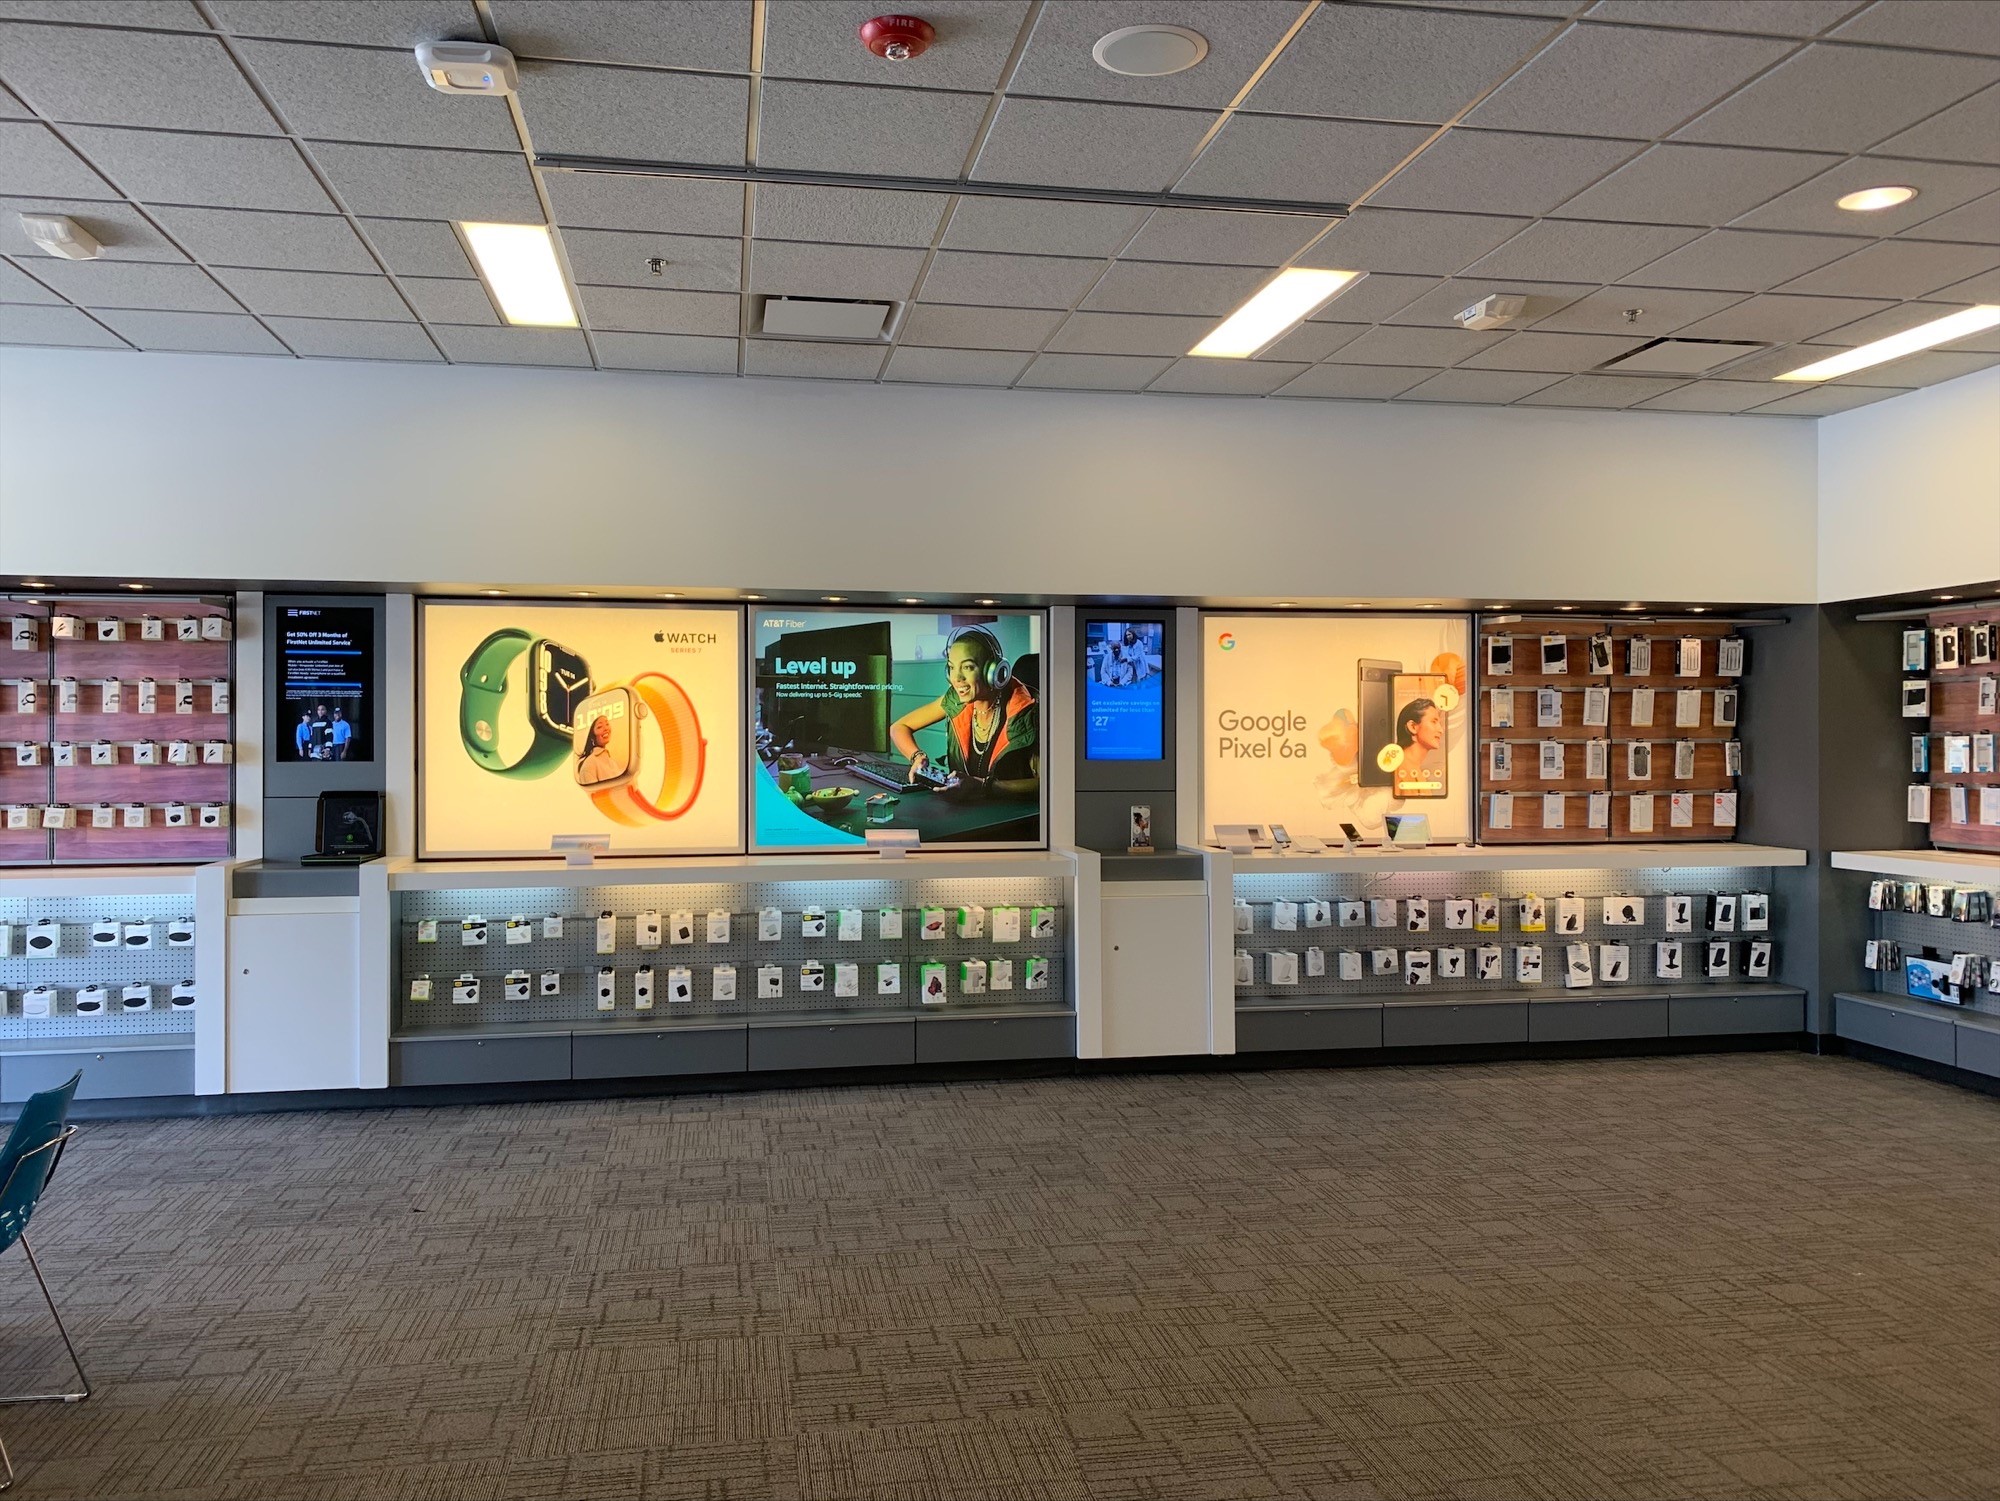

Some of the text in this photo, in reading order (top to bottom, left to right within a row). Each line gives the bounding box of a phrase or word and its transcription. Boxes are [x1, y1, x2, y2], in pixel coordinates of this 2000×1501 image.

[888, 18, 915, 28] FIRE
[763, 619, 784, 628] AT&T
[667, 633, 716, 644] WATCH
[775, 656, 857, 679] Level up
[829, 683, 880, 692] Straightforward
[881, 683, 904, 692] pricing.
[789, 691, 813, 699] delivering
[1218, 710, 1307, 737] Google
[1219, 737, 1307, 759] Pixel 6a
